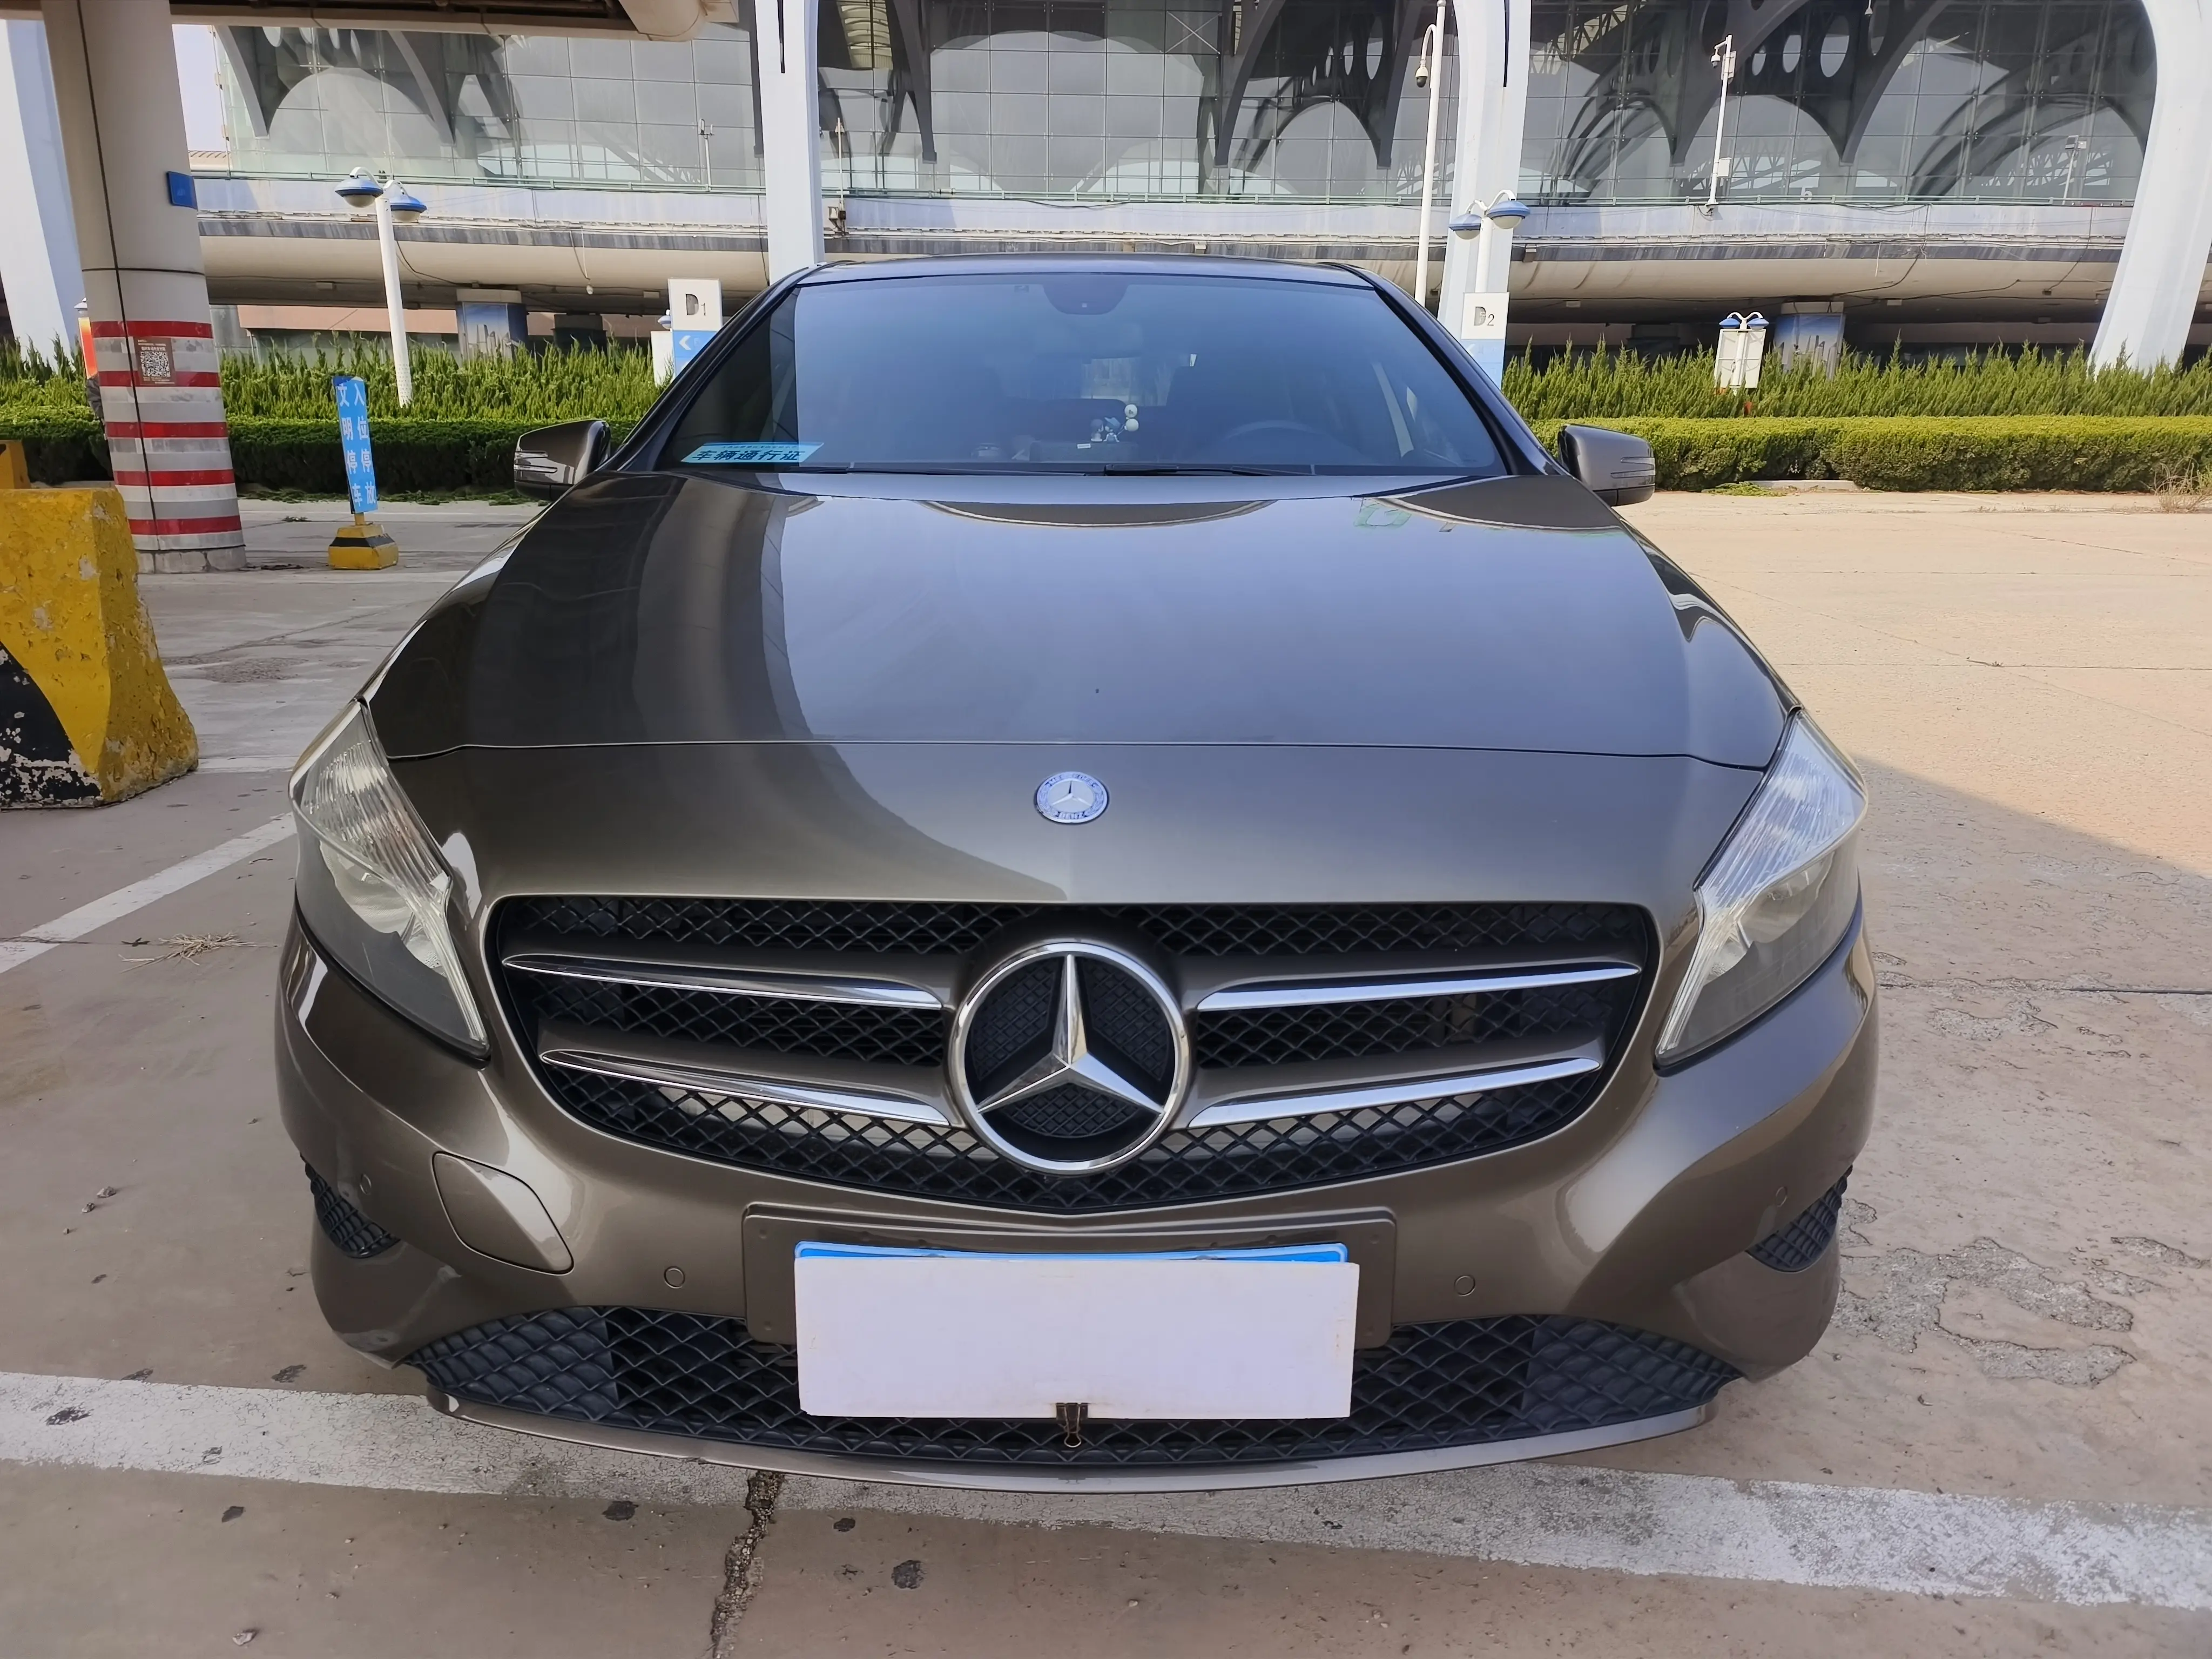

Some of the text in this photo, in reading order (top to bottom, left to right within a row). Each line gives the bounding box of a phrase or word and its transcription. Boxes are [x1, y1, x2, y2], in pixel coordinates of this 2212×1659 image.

[1474, 306, 1494, 326] D2
[338, 383, 363, 507] 文明停车
[354, 383, 376, 504] 入位停放
[692, 450, 805, 460] 车辆通行证
